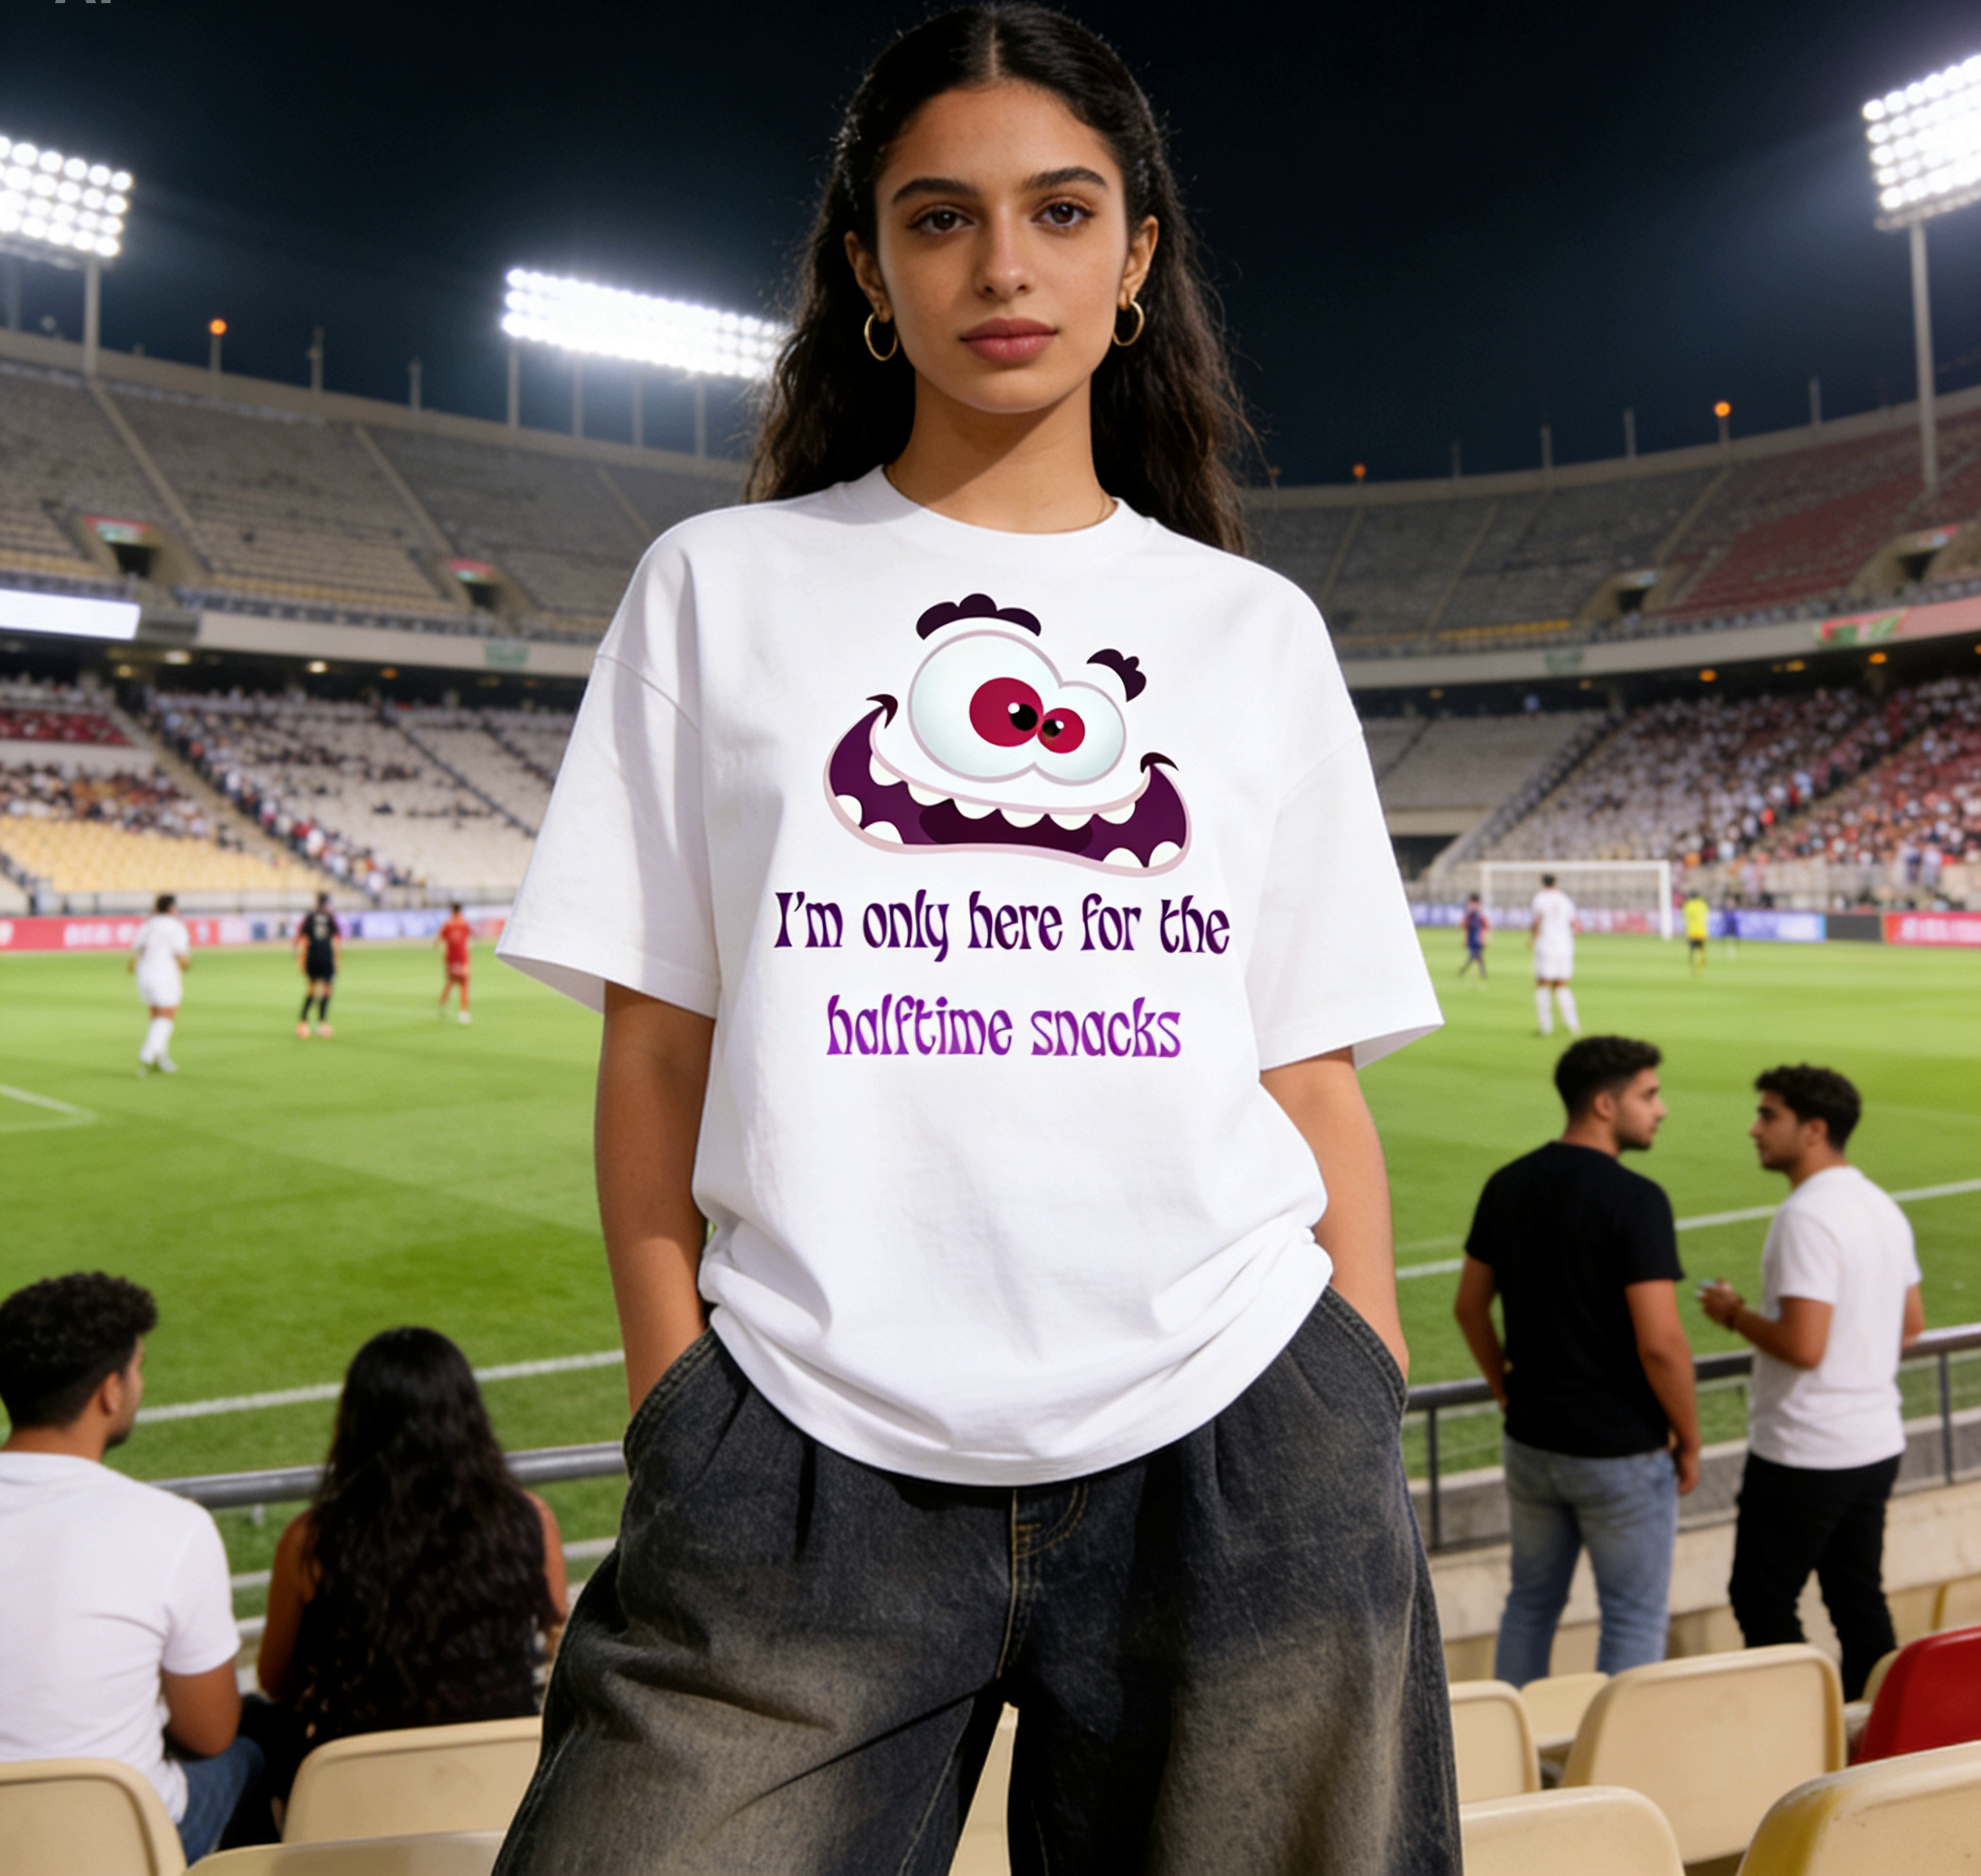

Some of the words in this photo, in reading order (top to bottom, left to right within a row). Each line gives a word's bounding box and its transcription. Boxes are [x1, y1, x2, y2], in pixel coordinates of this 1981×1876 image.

[774, 891, 842, 948] I'm
[863, 889, 949, 962] only
[968, 891, 1063, 951] here
[1080, 893, 1141, 950] for
[1160, 895, 1230, 954] the
[827, 994, 1012, 1055] halftime
[1031, 997, 1181, 1058] snacks
